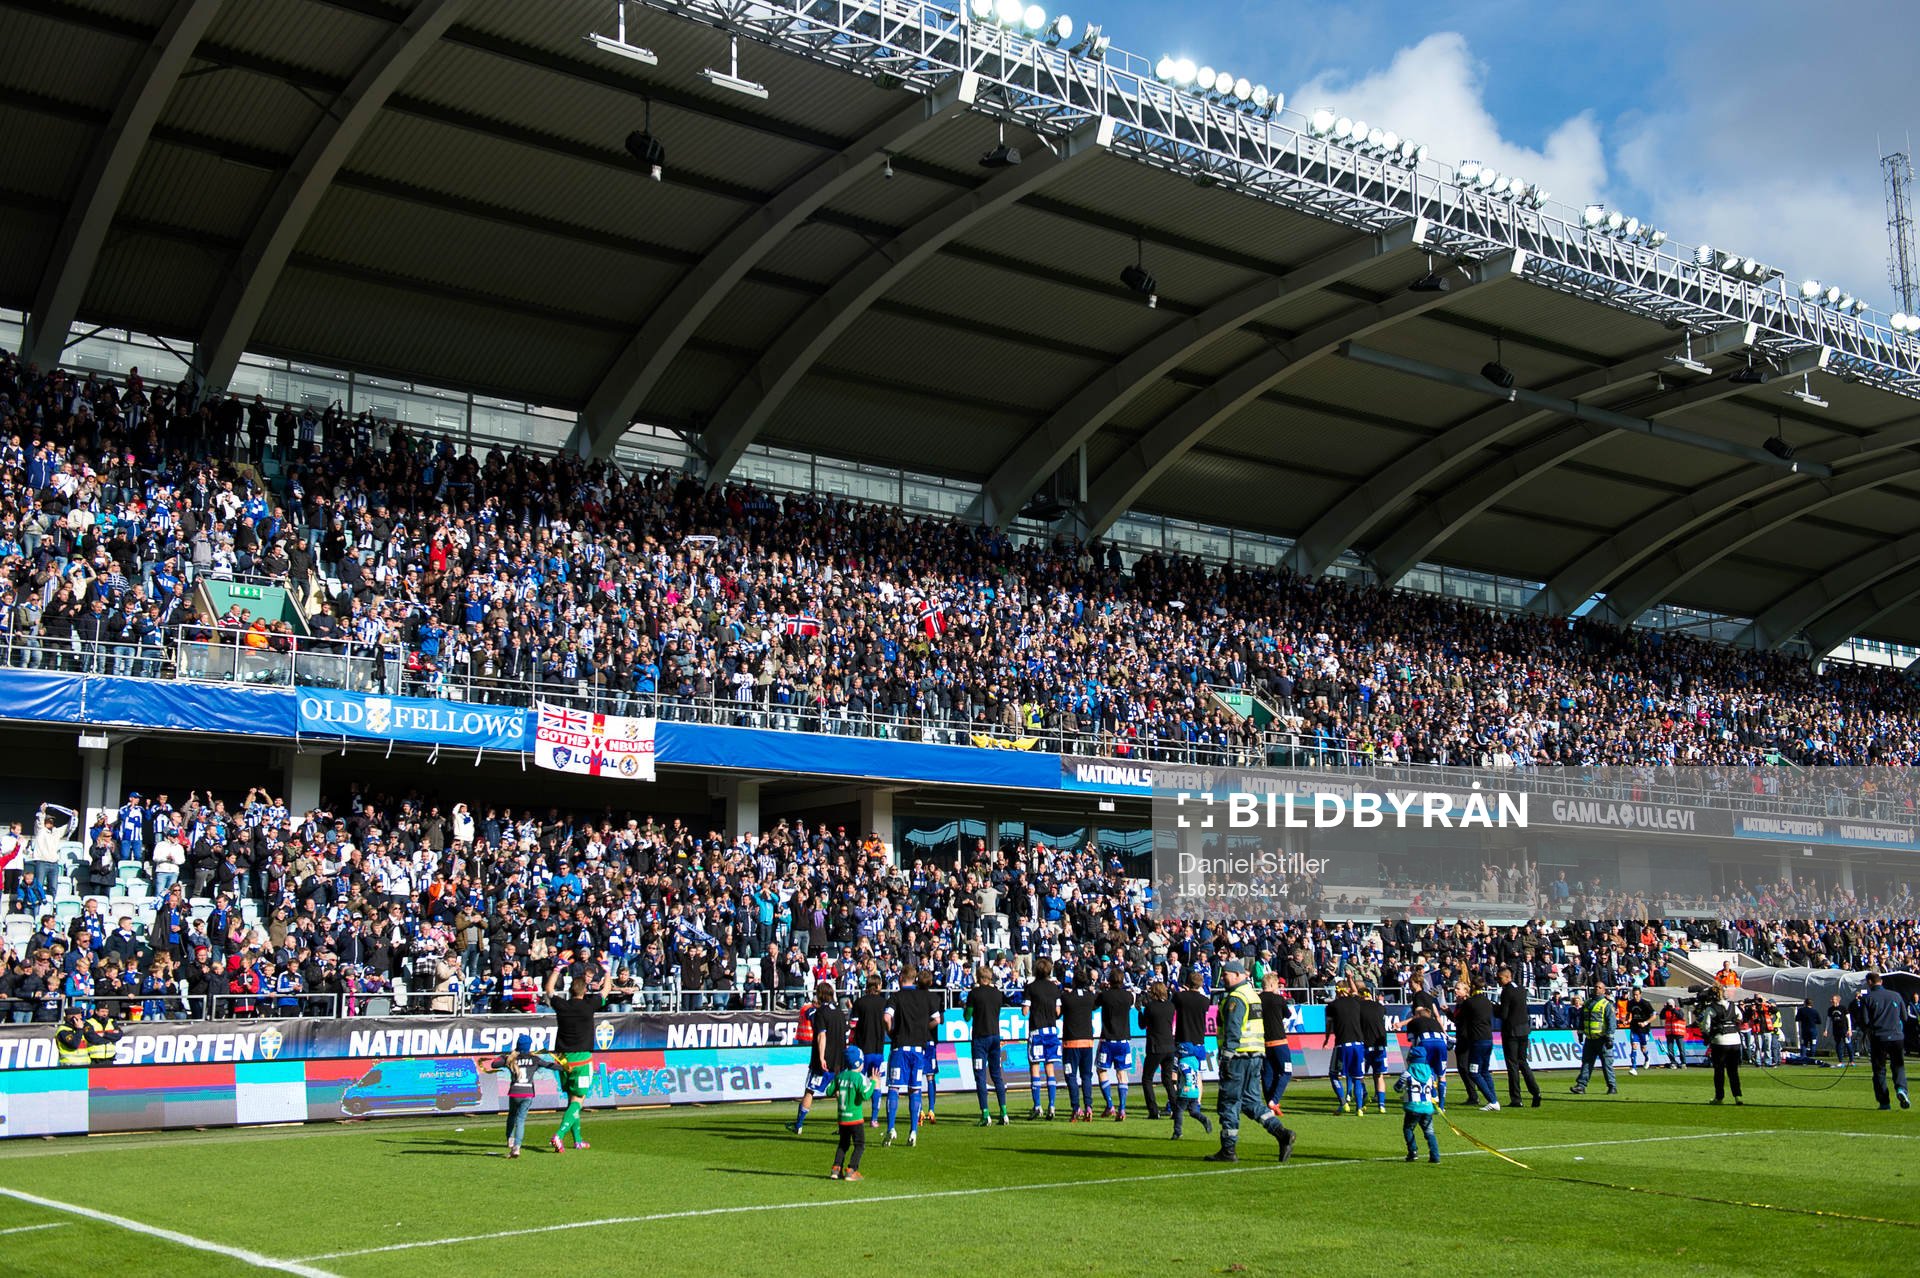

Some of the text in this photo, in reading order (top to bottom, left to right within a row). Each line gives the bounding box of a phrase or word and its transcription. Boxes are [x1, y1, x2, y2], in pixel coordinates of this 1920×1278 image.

[301, 698, 524, 738] OLD FELLOWS
[537, 727, 655, 752] GOTHE NBURG
[573, 754, 618, 769] LOYAL
[1076, 764, 1201, 791] NATIONALSPORTEN
[1552, 800, 1695, 831] GAMLA ULLEVI
[1743, 817, 1817, 837] NATIONALSPORTEN
[1840, 825, 1909, 844] NATIONALSPORTEN
[349, 1026, 558, 1057] NATIONALSPORT
[666, 1021, 797, 1049] NATIONALSP
